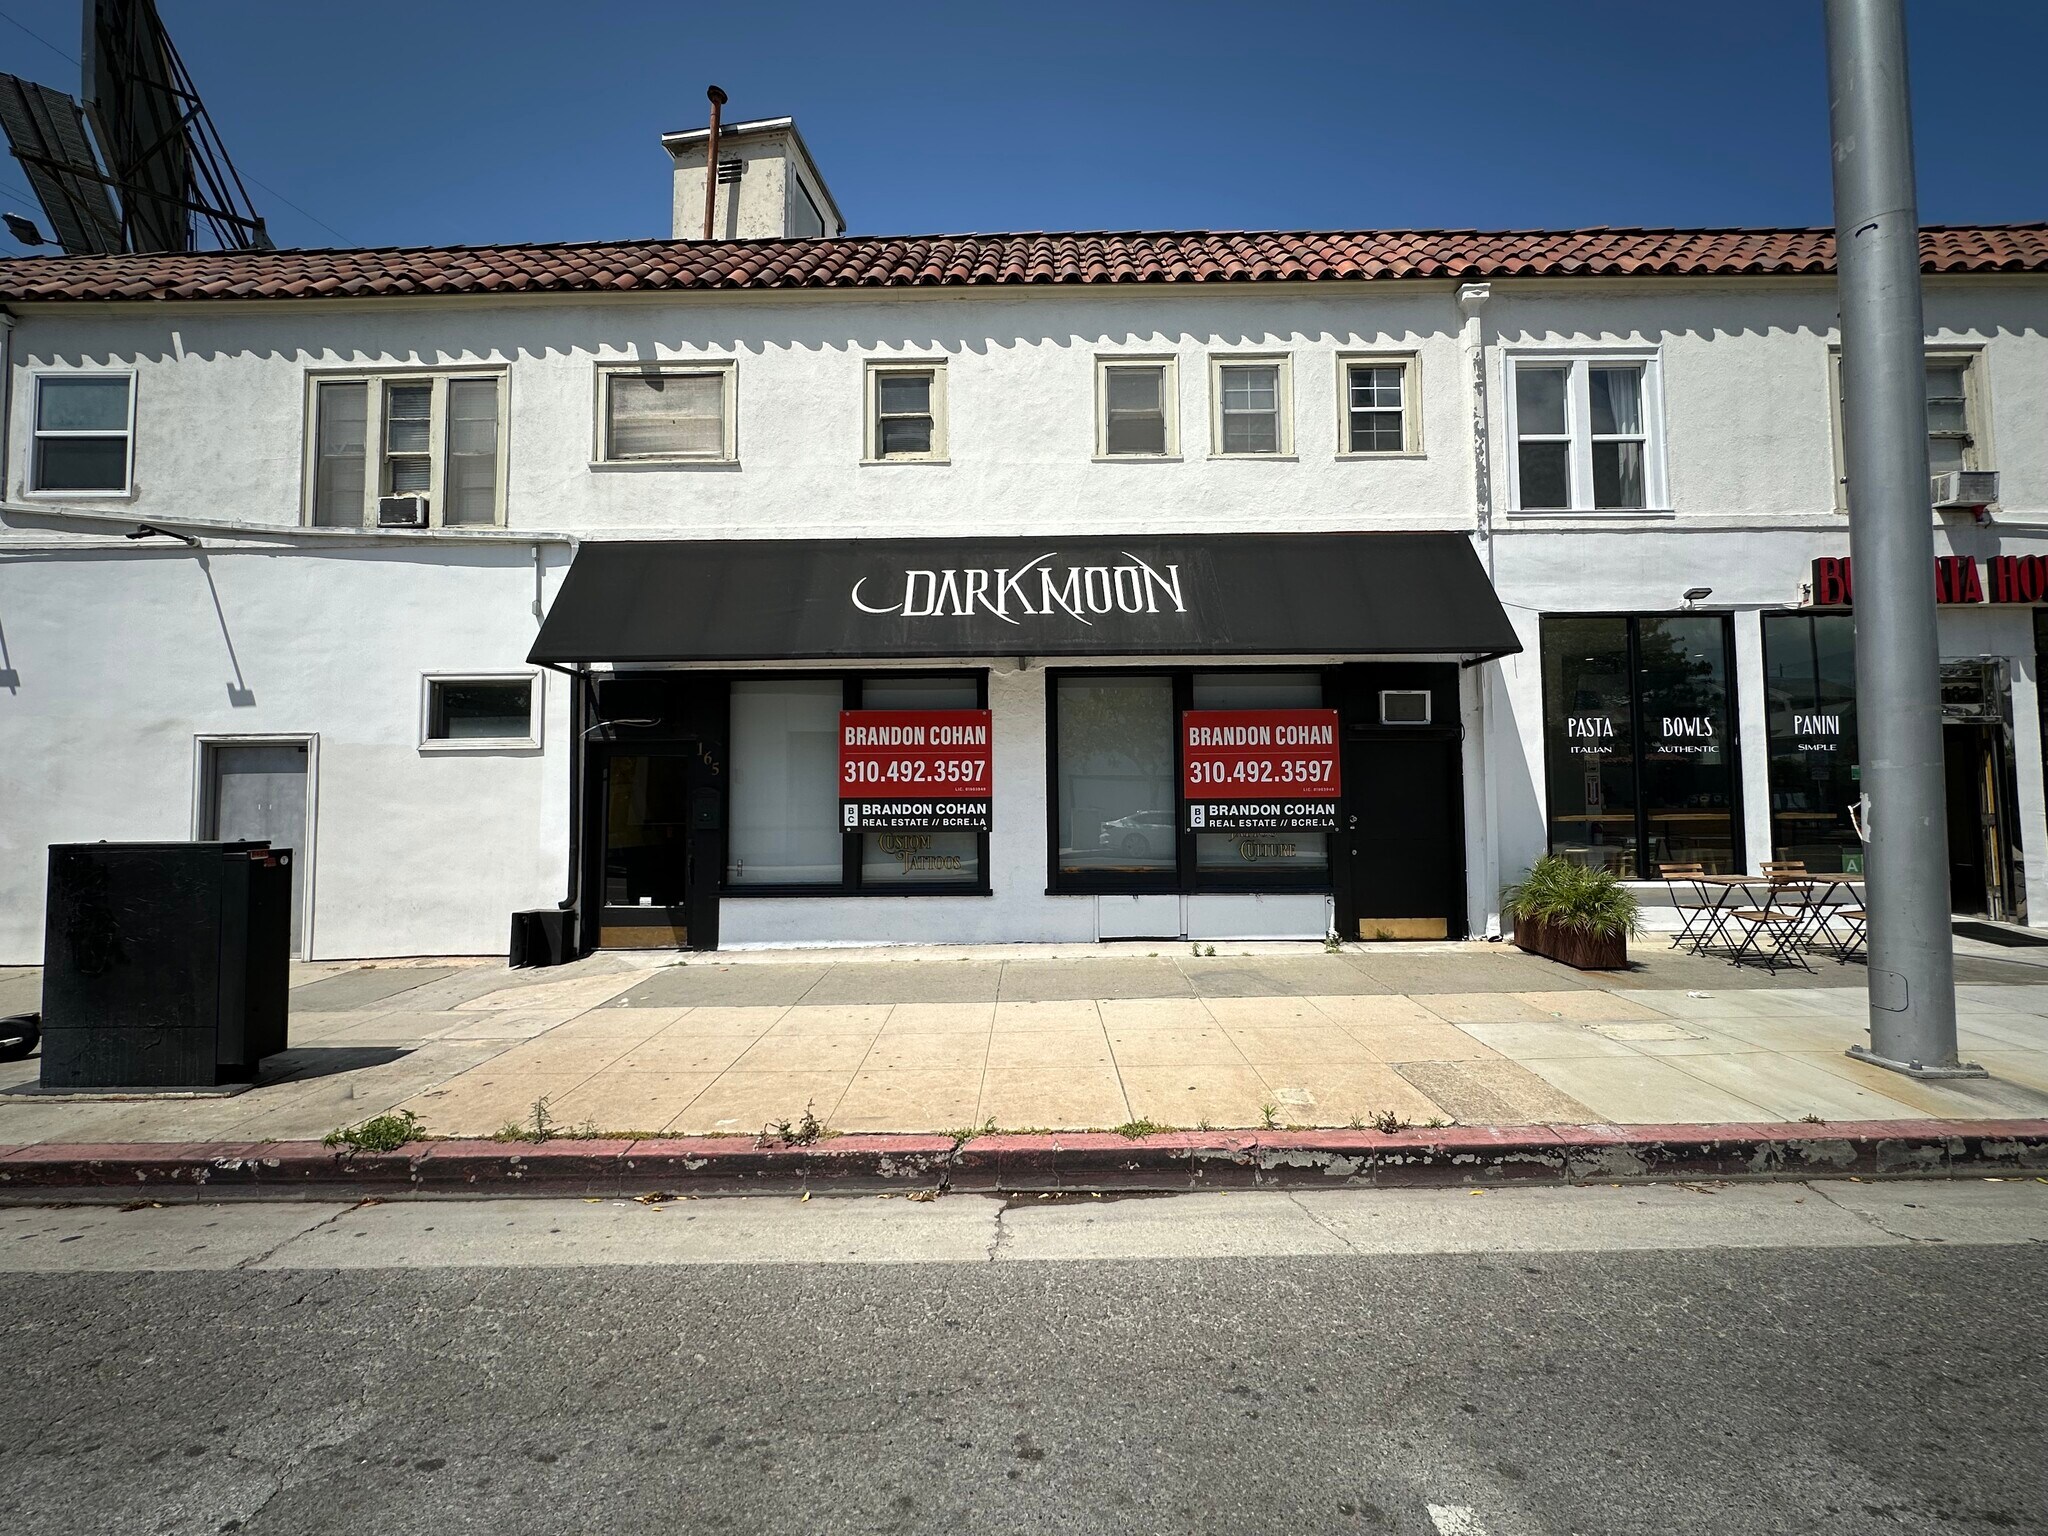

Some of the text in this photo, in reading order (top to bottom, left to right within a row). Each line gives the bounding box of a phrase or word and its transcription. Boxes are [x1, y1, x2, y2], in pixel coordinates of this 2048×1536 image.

[1997, 554, 2048, 604] HO
[1568, 717, 1614, 738] PASTA
[1662, 717, 1713, 737] BOWLS
[1794, 715, 1840, 735] PANINI
[845, 726, 986, 746] BRANDON COHAN
[1189, 725, 1333, 746] BRANDON COHAN
[1570, 746, 1613, 754] ITALIAN
[1657, 745, 1720, 753] AUTHENTIC
[1797, 743, 1838, 751] SIMPLE
[697, 742, 720, 776] 165
[844, 760, 986, 783] 310.492.3597
[1189, 760, 1333, 783] 310.492.3597
[862, 803, 987, 815] BRANDON COHAN
[1209, 803, 1335, 816] BRANDON COHAN
[862, 818, 888, 827] REAL
[891, 818, 929, 827] ESTATE
[942, 817, 987, 826] BCRE.LA
[1209, 819, 1236, 828] REAL
[1239, 819, 1277, 827] ESTATE
[1291, 818, 1335, 827] BCRE.LA
[1846, 859, 1859, 872] A
